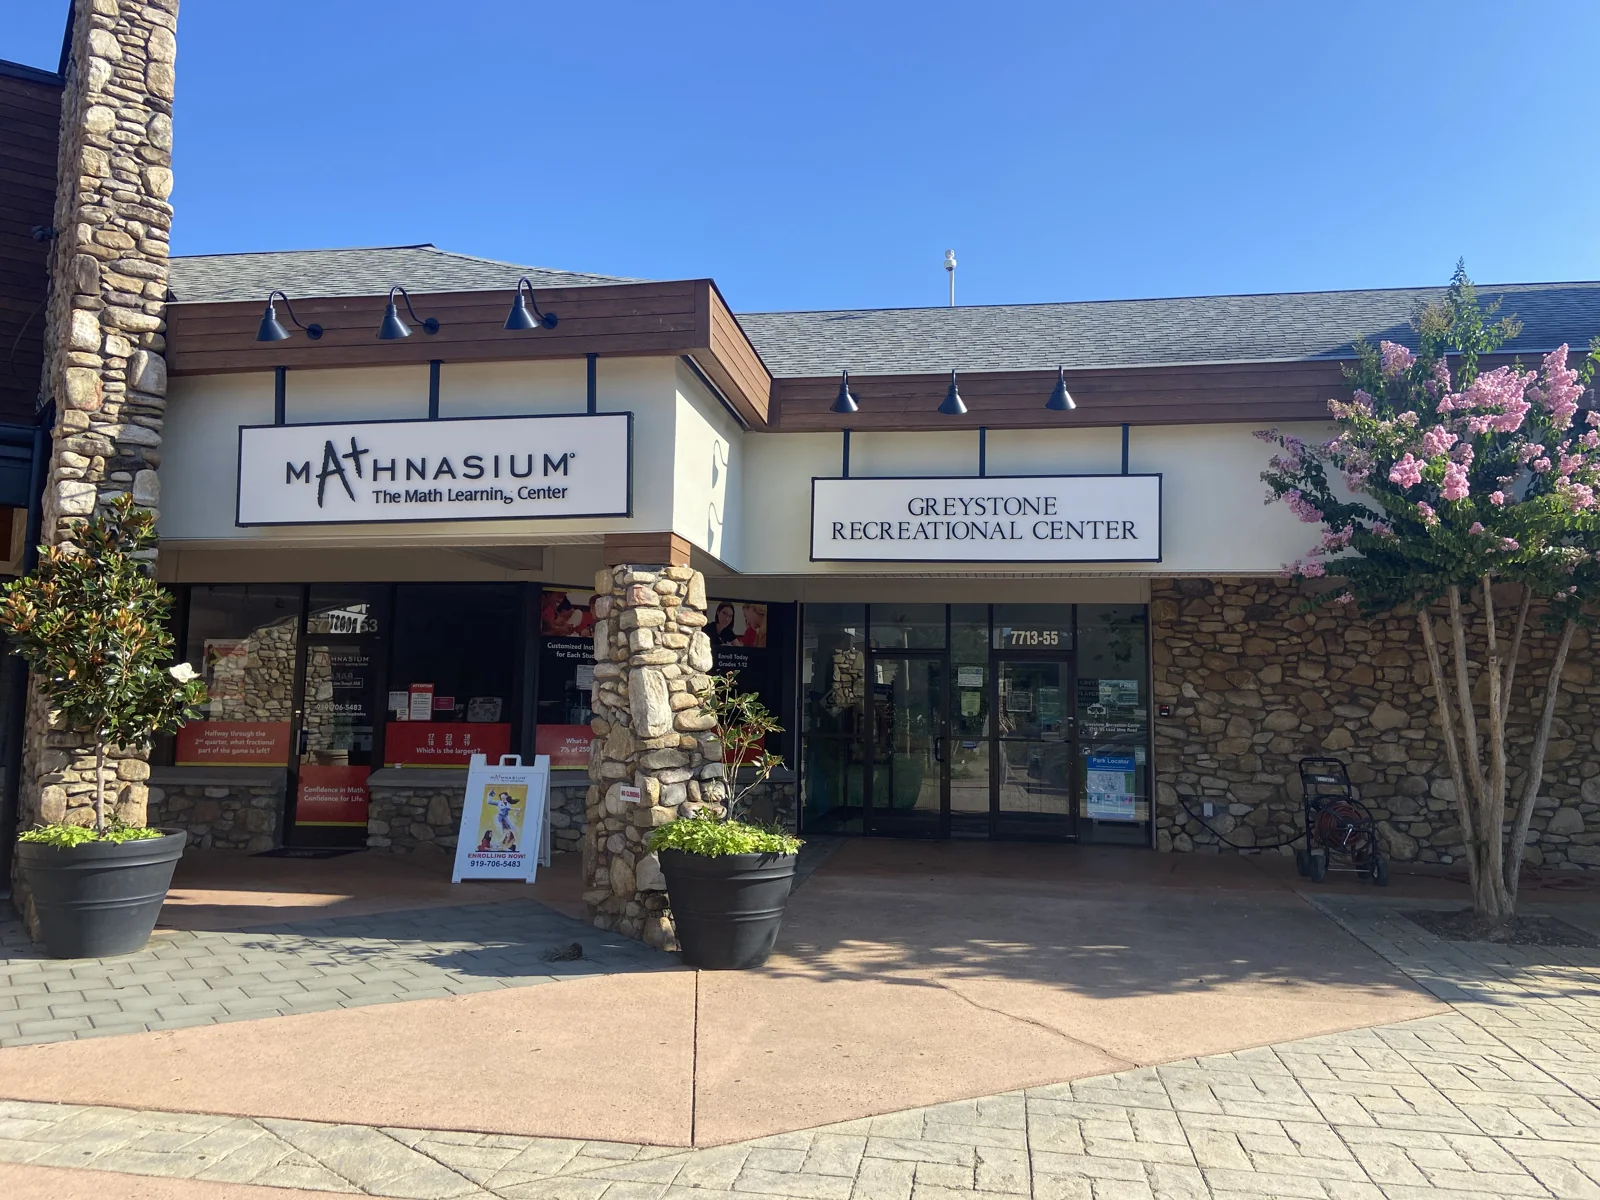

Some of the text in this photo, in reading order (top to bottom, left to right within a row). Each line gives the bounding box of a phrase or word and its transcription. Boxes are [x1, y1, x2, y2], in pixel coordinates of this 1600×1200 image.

[372, 486, 568, 504] The Math Learning Center
[908, 496, 1057, 516] GREYSTONE
[831, 520, 1138, 540] RECREATIONAL CENTER
[1010, 630, 1059, 645] 7713-55
[547, 642, 582, 650] Customized
[230, 730, 255, 738] through
[455, 747, 481, 756] largest?
[470, 860, 521, 868] 919-706-5483
